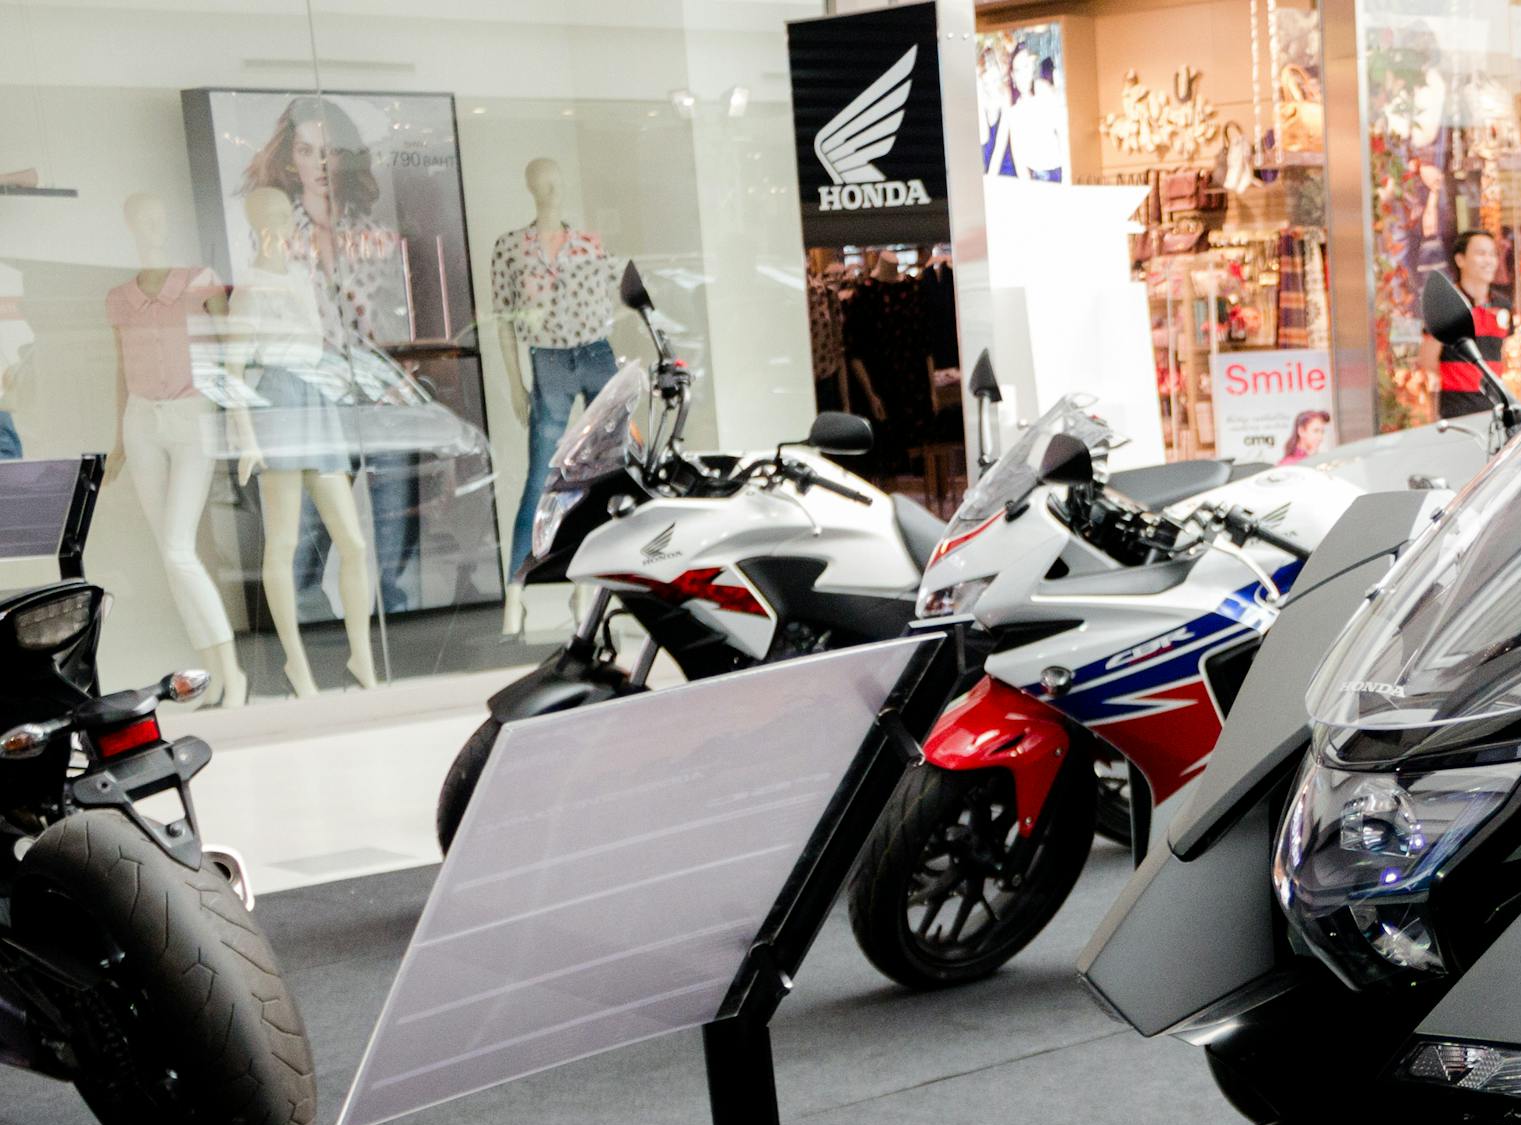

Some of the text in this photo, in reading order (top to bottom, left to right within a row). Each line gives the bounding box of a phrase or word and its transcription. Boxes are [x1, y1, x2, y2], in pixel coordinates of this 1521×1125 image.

[818, 179, 932, 211] HONDA
[1226, 361, 1326, 396] Smile
[1105, 626, 1195, 670] CBR
[1340, 681, 1406, 698] HONDA
